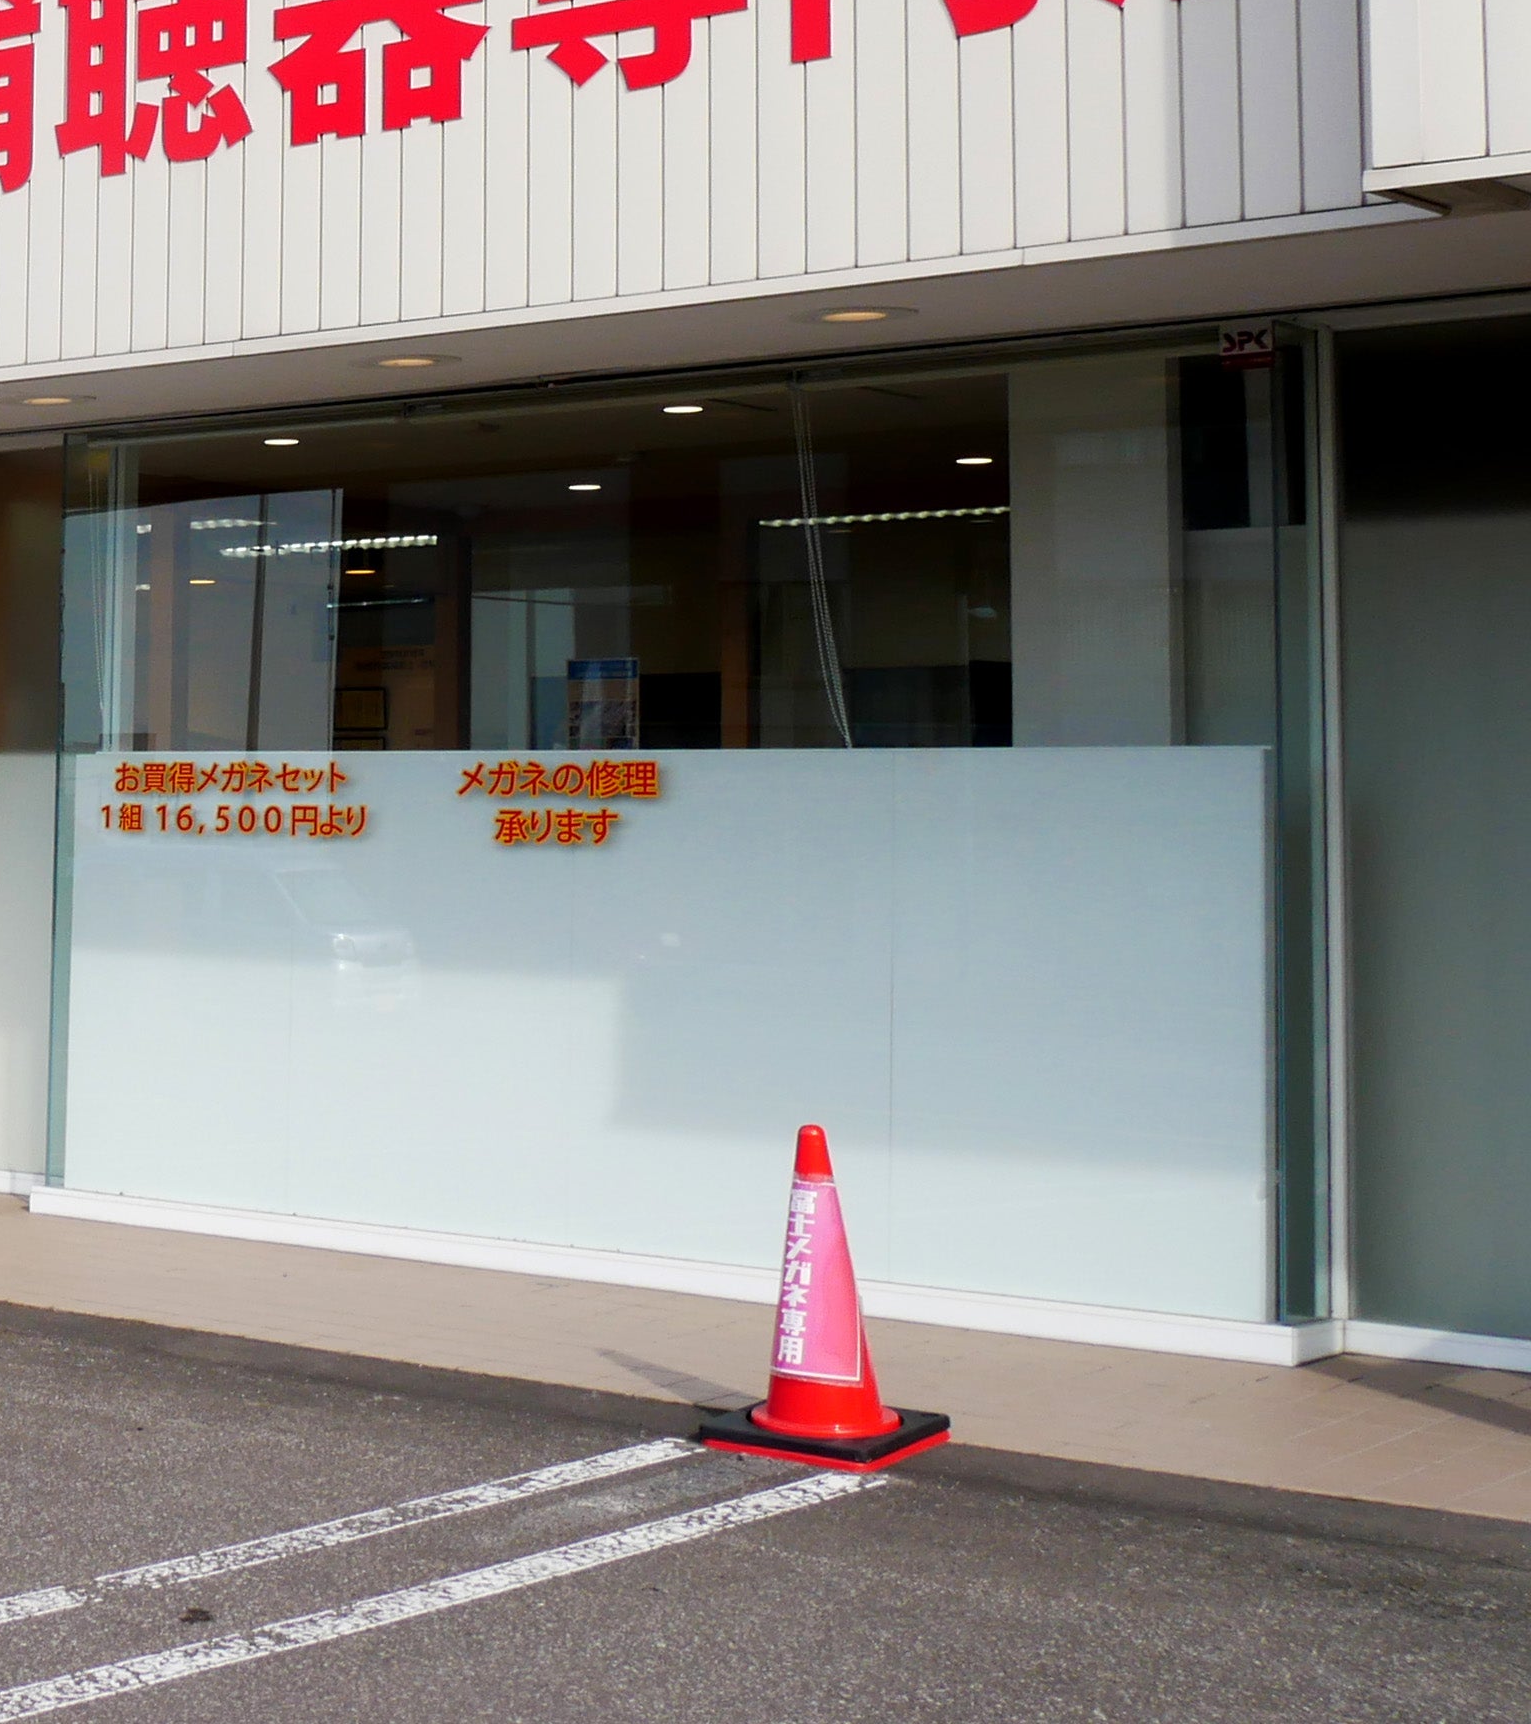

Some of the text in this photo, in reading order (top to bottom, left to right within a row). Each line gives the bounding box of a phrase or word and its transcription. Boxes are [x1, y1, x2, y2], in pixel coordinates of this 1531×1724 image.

[114, 761, 347, 794] お買得メガネセット
[457, 760, 659, 799] メガネの修理
[494, 807, 621, 845] 承ります
[777, 1188, 818, 1365] 富士メガネ専用
